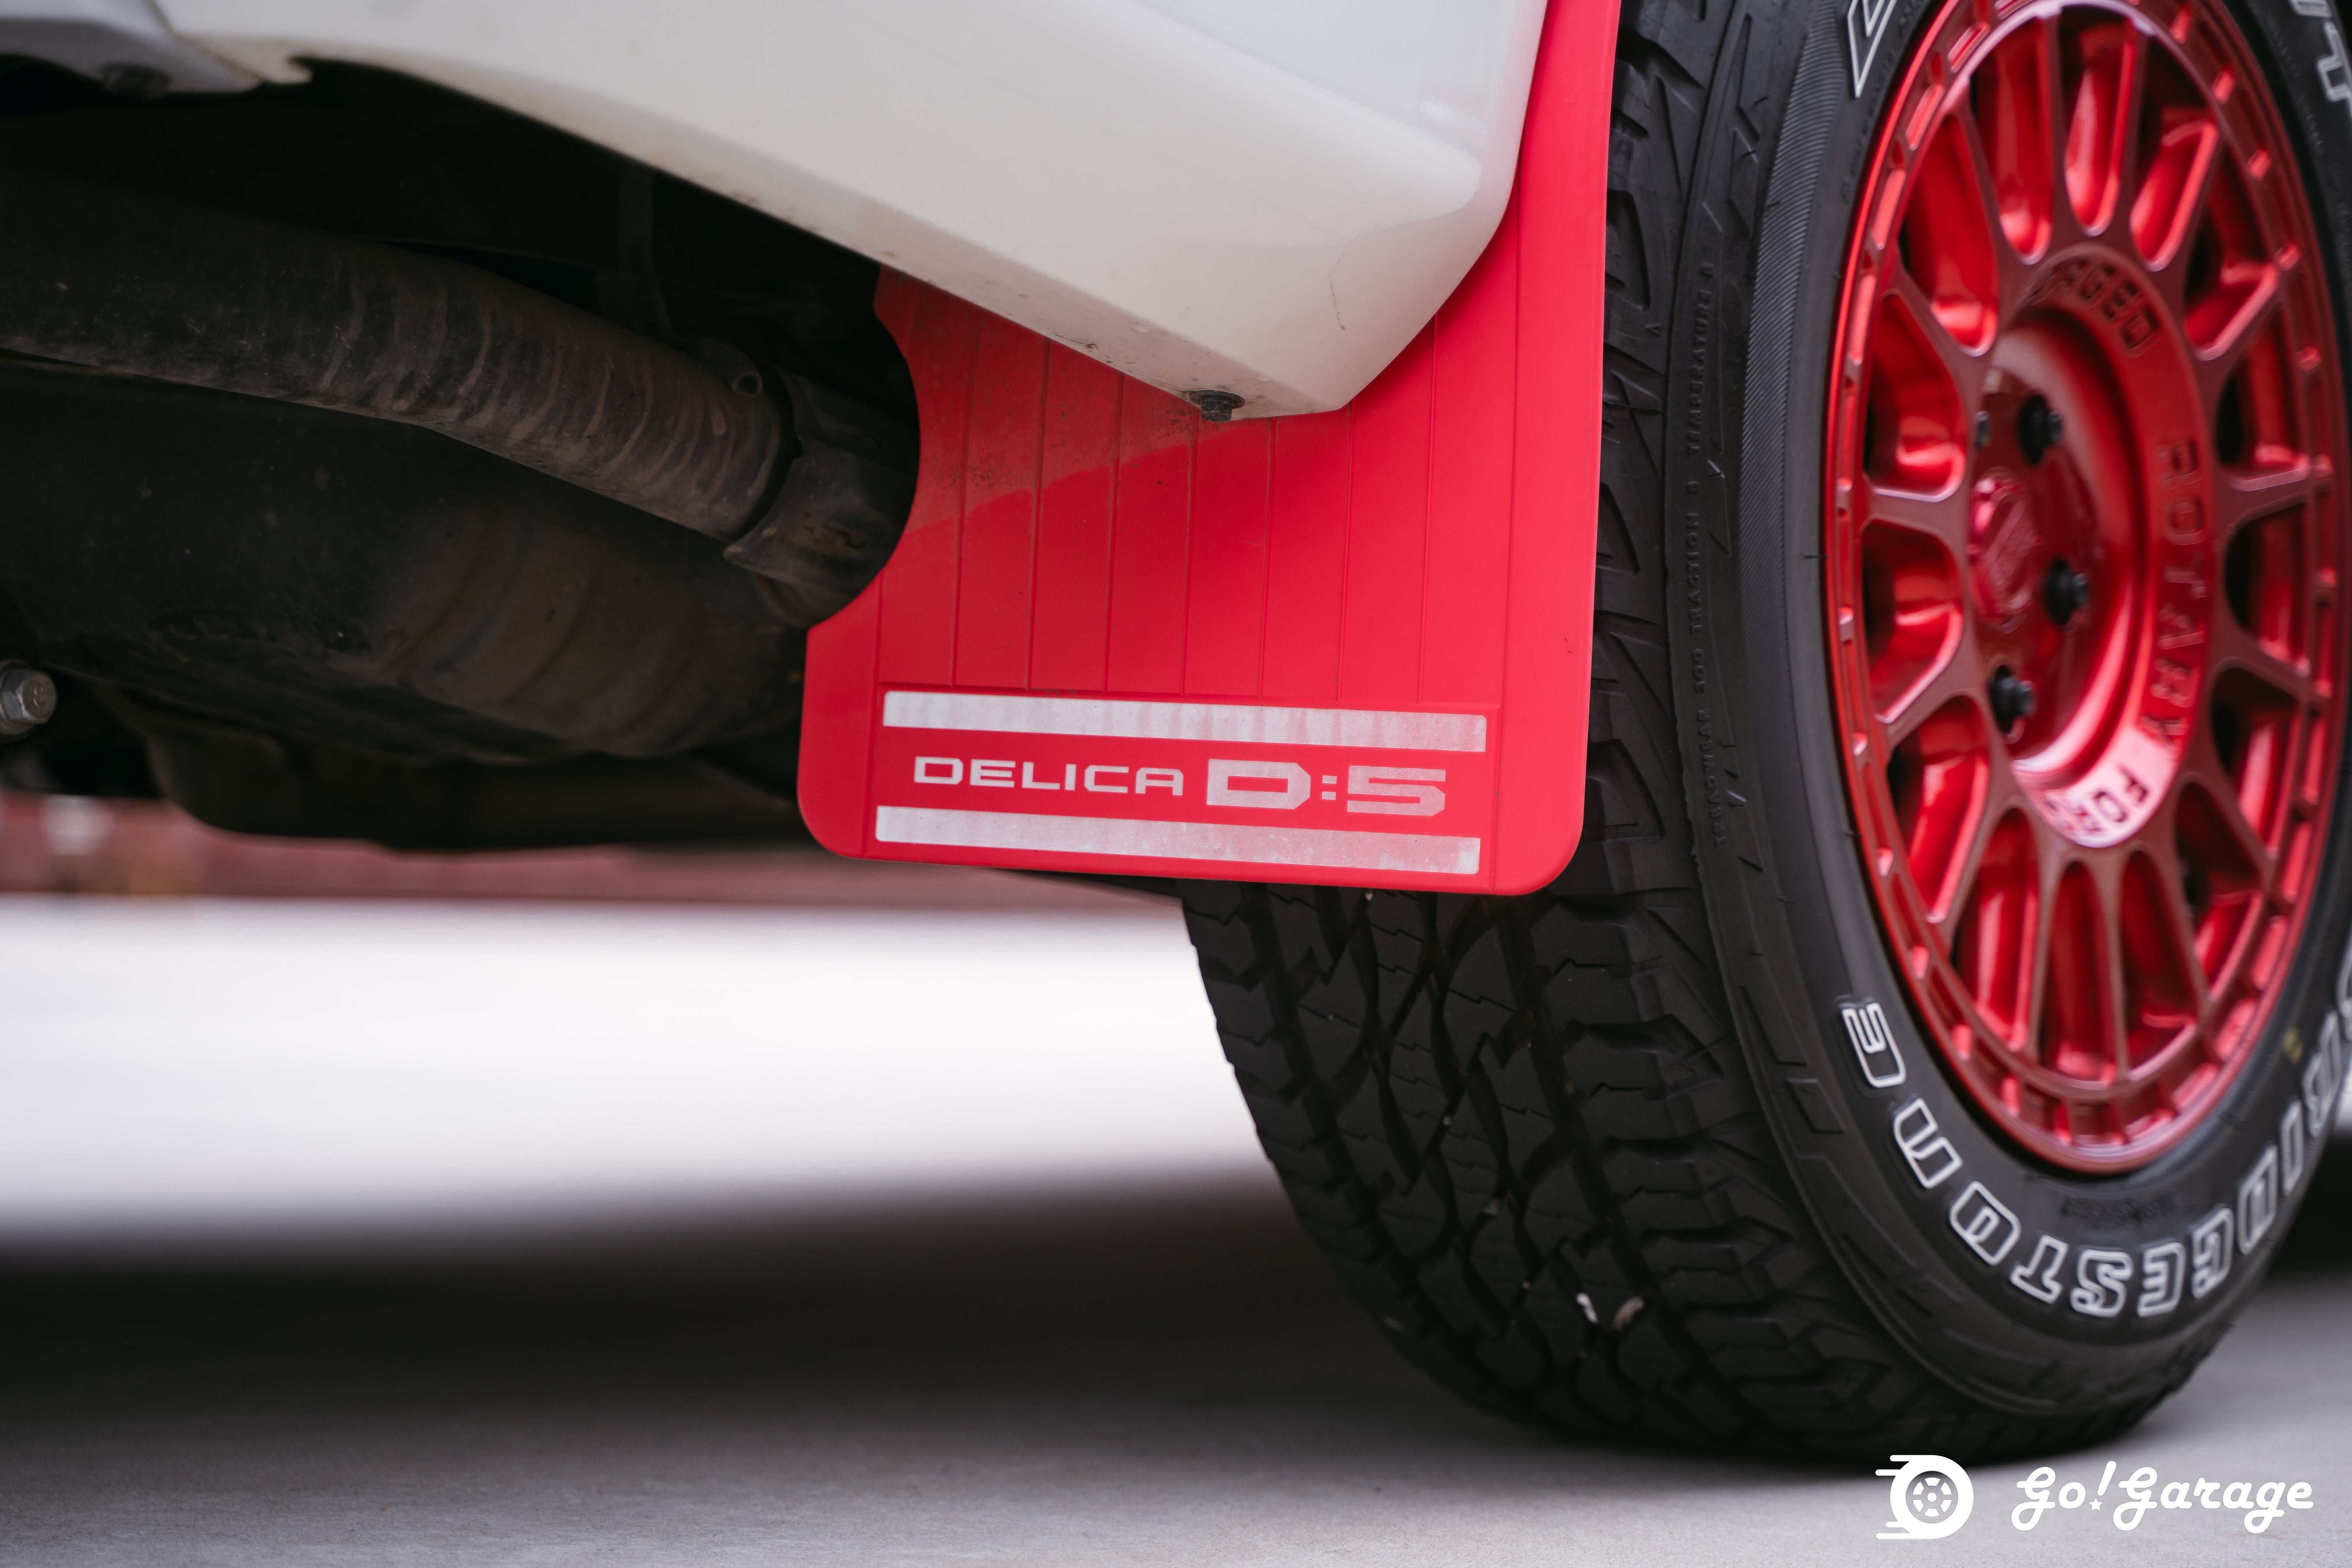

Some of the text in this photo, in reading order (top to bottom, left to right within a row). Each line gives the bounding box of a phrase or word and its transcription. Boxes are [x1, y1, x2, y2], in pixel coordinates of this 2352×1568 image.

[1687, 289, 1712, 455] TEMPERATURE
[1686, 513, 1702, 634] TRACTION
[1691, 649, 1706, 693] 300
[913, 756, 1446, 816] DELICA D:5
[1697, 708, 1727, 848] TREADWEAR
